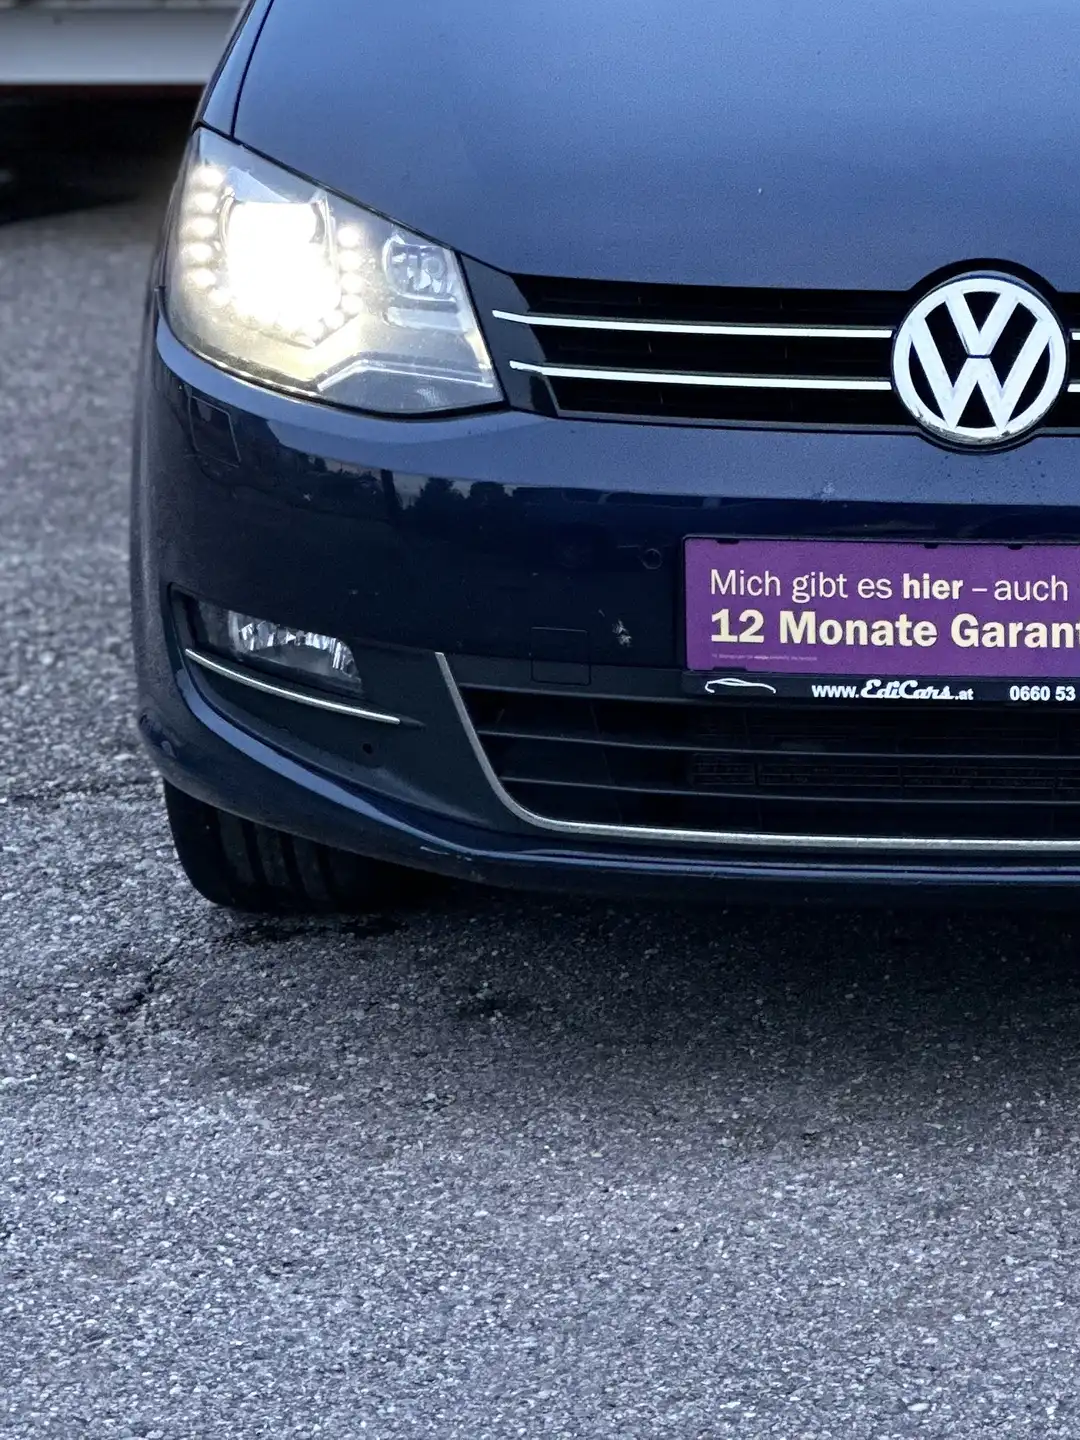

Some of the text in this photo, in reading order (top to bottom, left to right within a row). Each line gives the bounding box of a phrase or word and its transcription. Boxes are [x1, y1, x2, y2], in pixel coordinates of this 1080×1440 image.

[711, 569, 781, 596] Mich
[791, 572, 848, 603] gibt
[857, 577, 893, 599] es
[902, 573, 963, 600] hier
[994, 575, 1068, 601] auch
[711, 608, 765, 643] 12
[779, 610, 938, 647] Monate
[811, 679, 974, 701] www.EdiCars.at
[1009, 685, 1050, 701] 0660
[1054, 686, 1076, 702] 53
